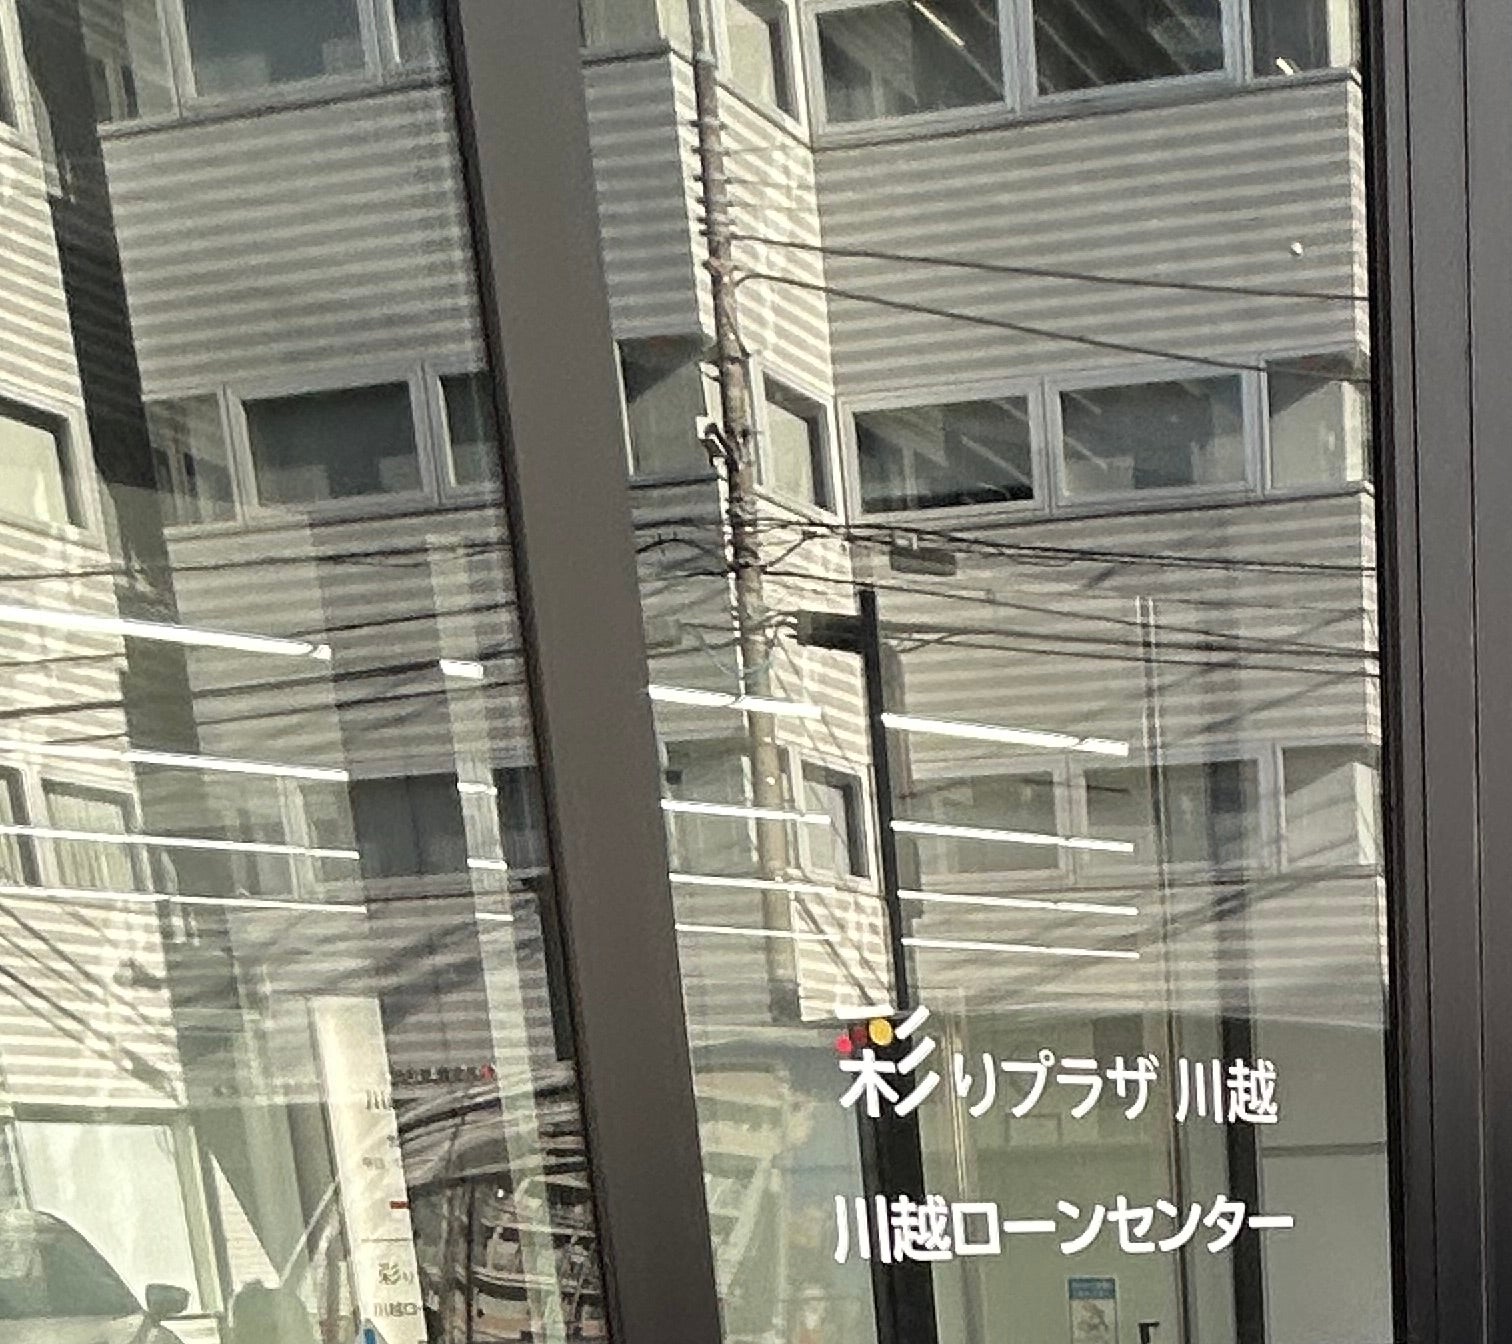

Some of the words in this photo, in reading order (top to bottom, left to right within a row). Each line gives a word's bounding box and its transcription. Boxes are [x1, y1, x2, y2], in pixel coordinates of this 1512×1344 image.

[835, 1004, 1158, 1120] 彩りプラザ
[1175, 1058, 1279, 1124] 川越
[834, 1194, 1295, 1264] 川越ローンセンター
